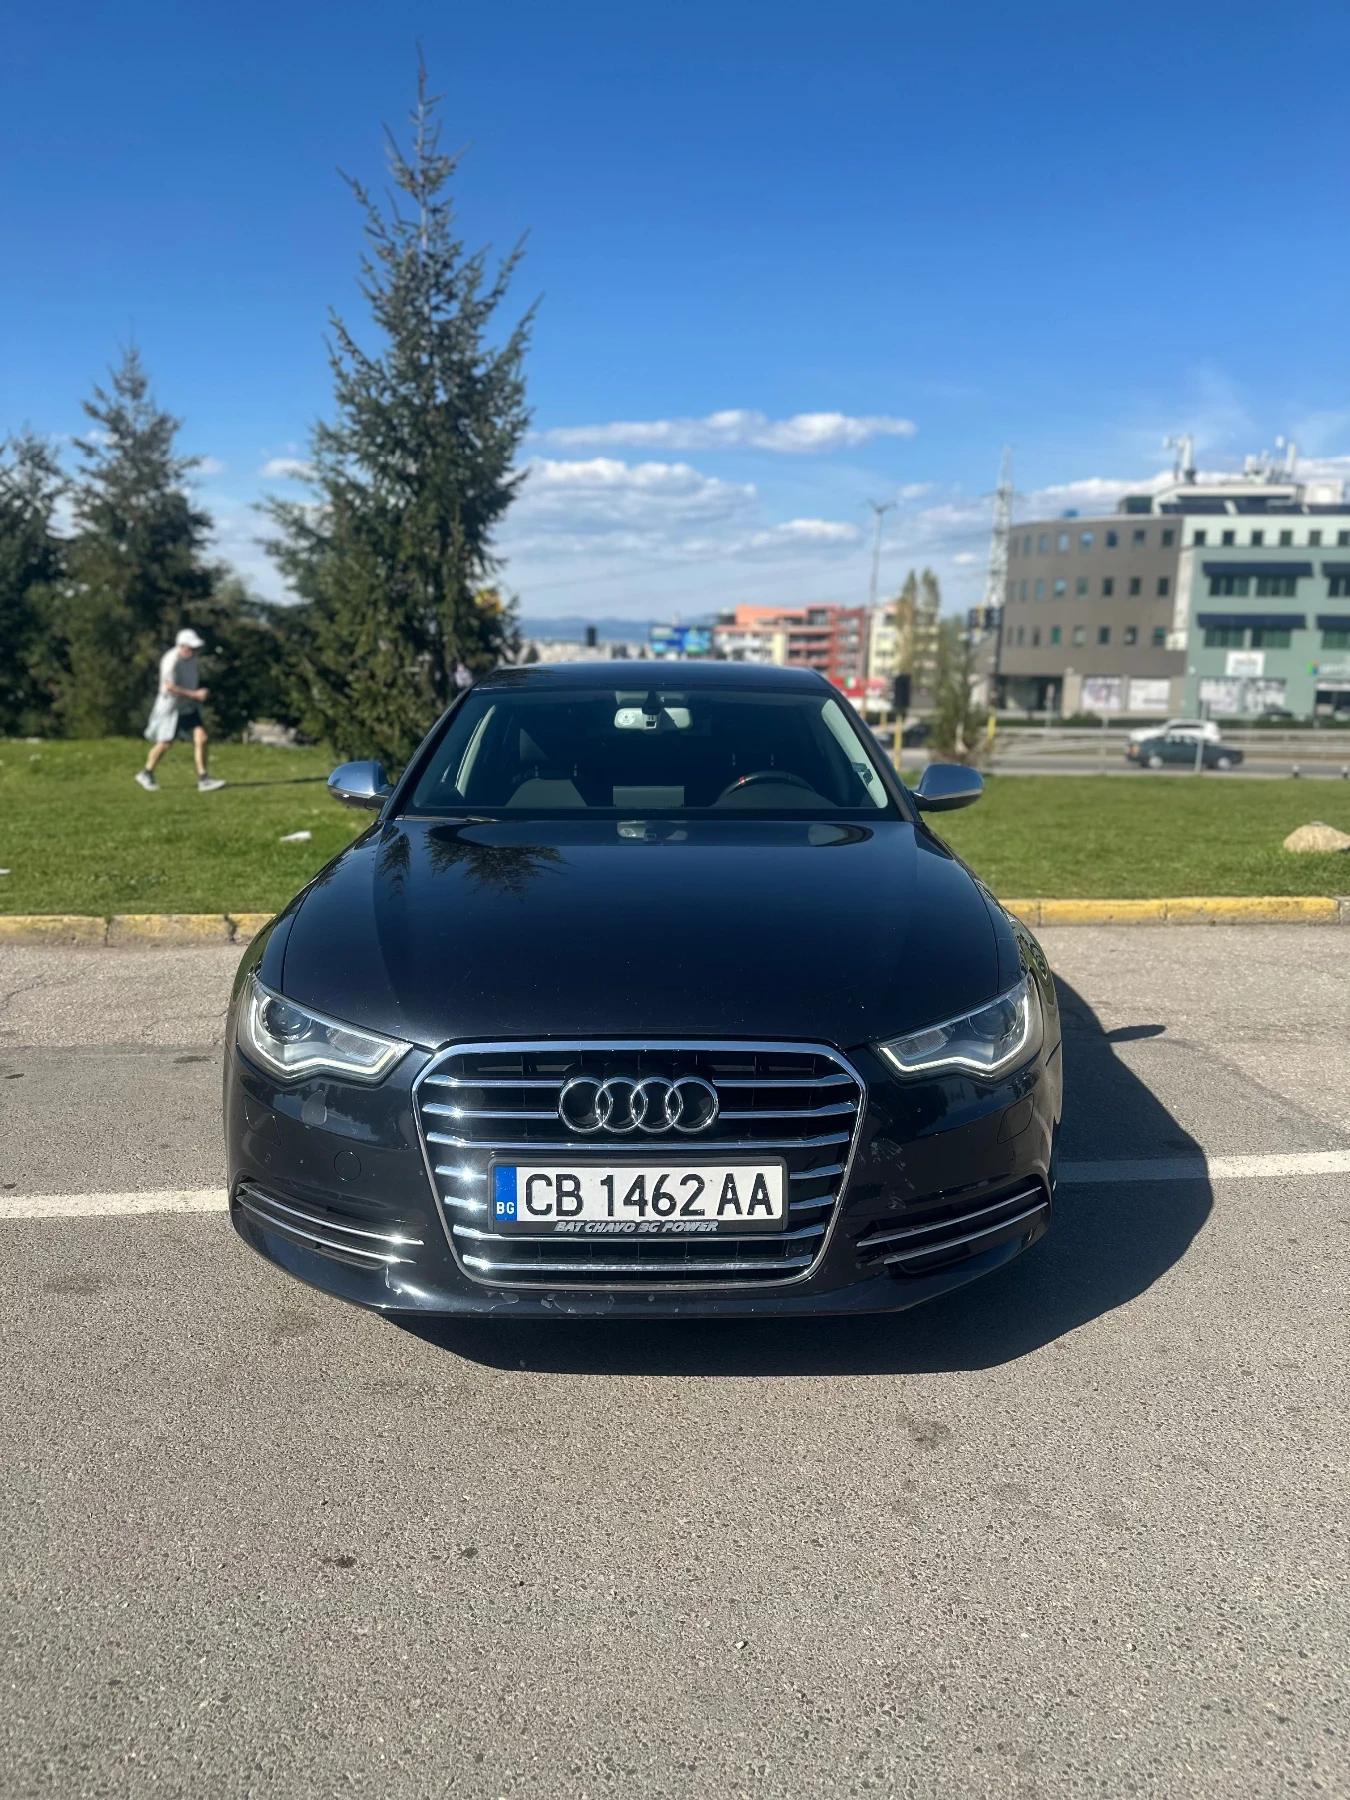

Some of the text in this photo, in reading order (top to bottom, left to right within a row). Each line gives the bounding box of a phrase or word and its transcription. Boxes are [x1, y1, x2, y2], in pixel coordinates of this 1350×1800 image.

[525, 1172, 774, 1217] CB 1462 AA
[496, 1201, 515, 1215] BG
[554, 1220, 719, 1233] BAT CHAVO BG POWER
